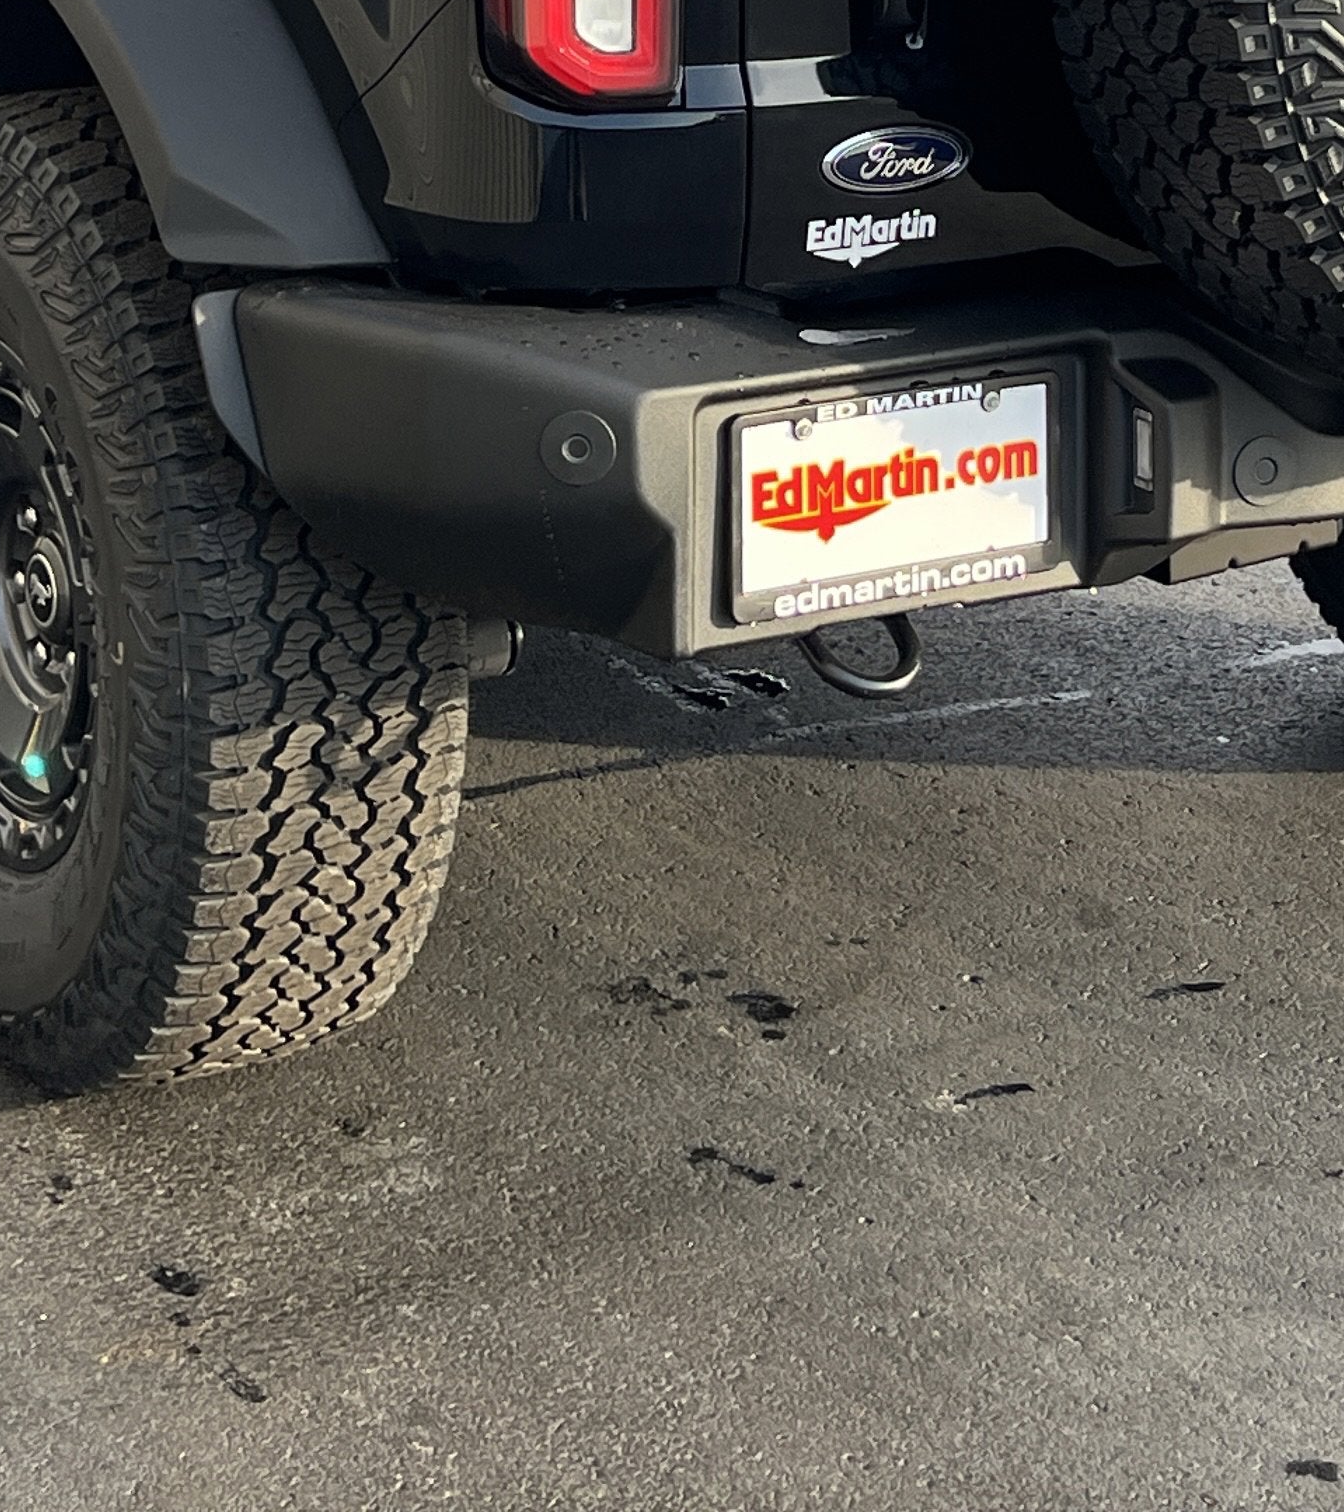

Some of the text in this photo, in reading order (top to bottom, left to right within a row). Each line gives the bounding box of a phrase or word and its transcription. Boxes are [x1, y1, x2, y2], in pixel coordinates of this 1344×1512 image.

[861, 142, 935, 180] Ford
[806, 209, 936, 253] EdMartin
[816, 383, 983, 422] ED MARTIN
[751, 439, 1038, 524] EdMartin.com
[774, 551, 1026, 619] edmartin.com
